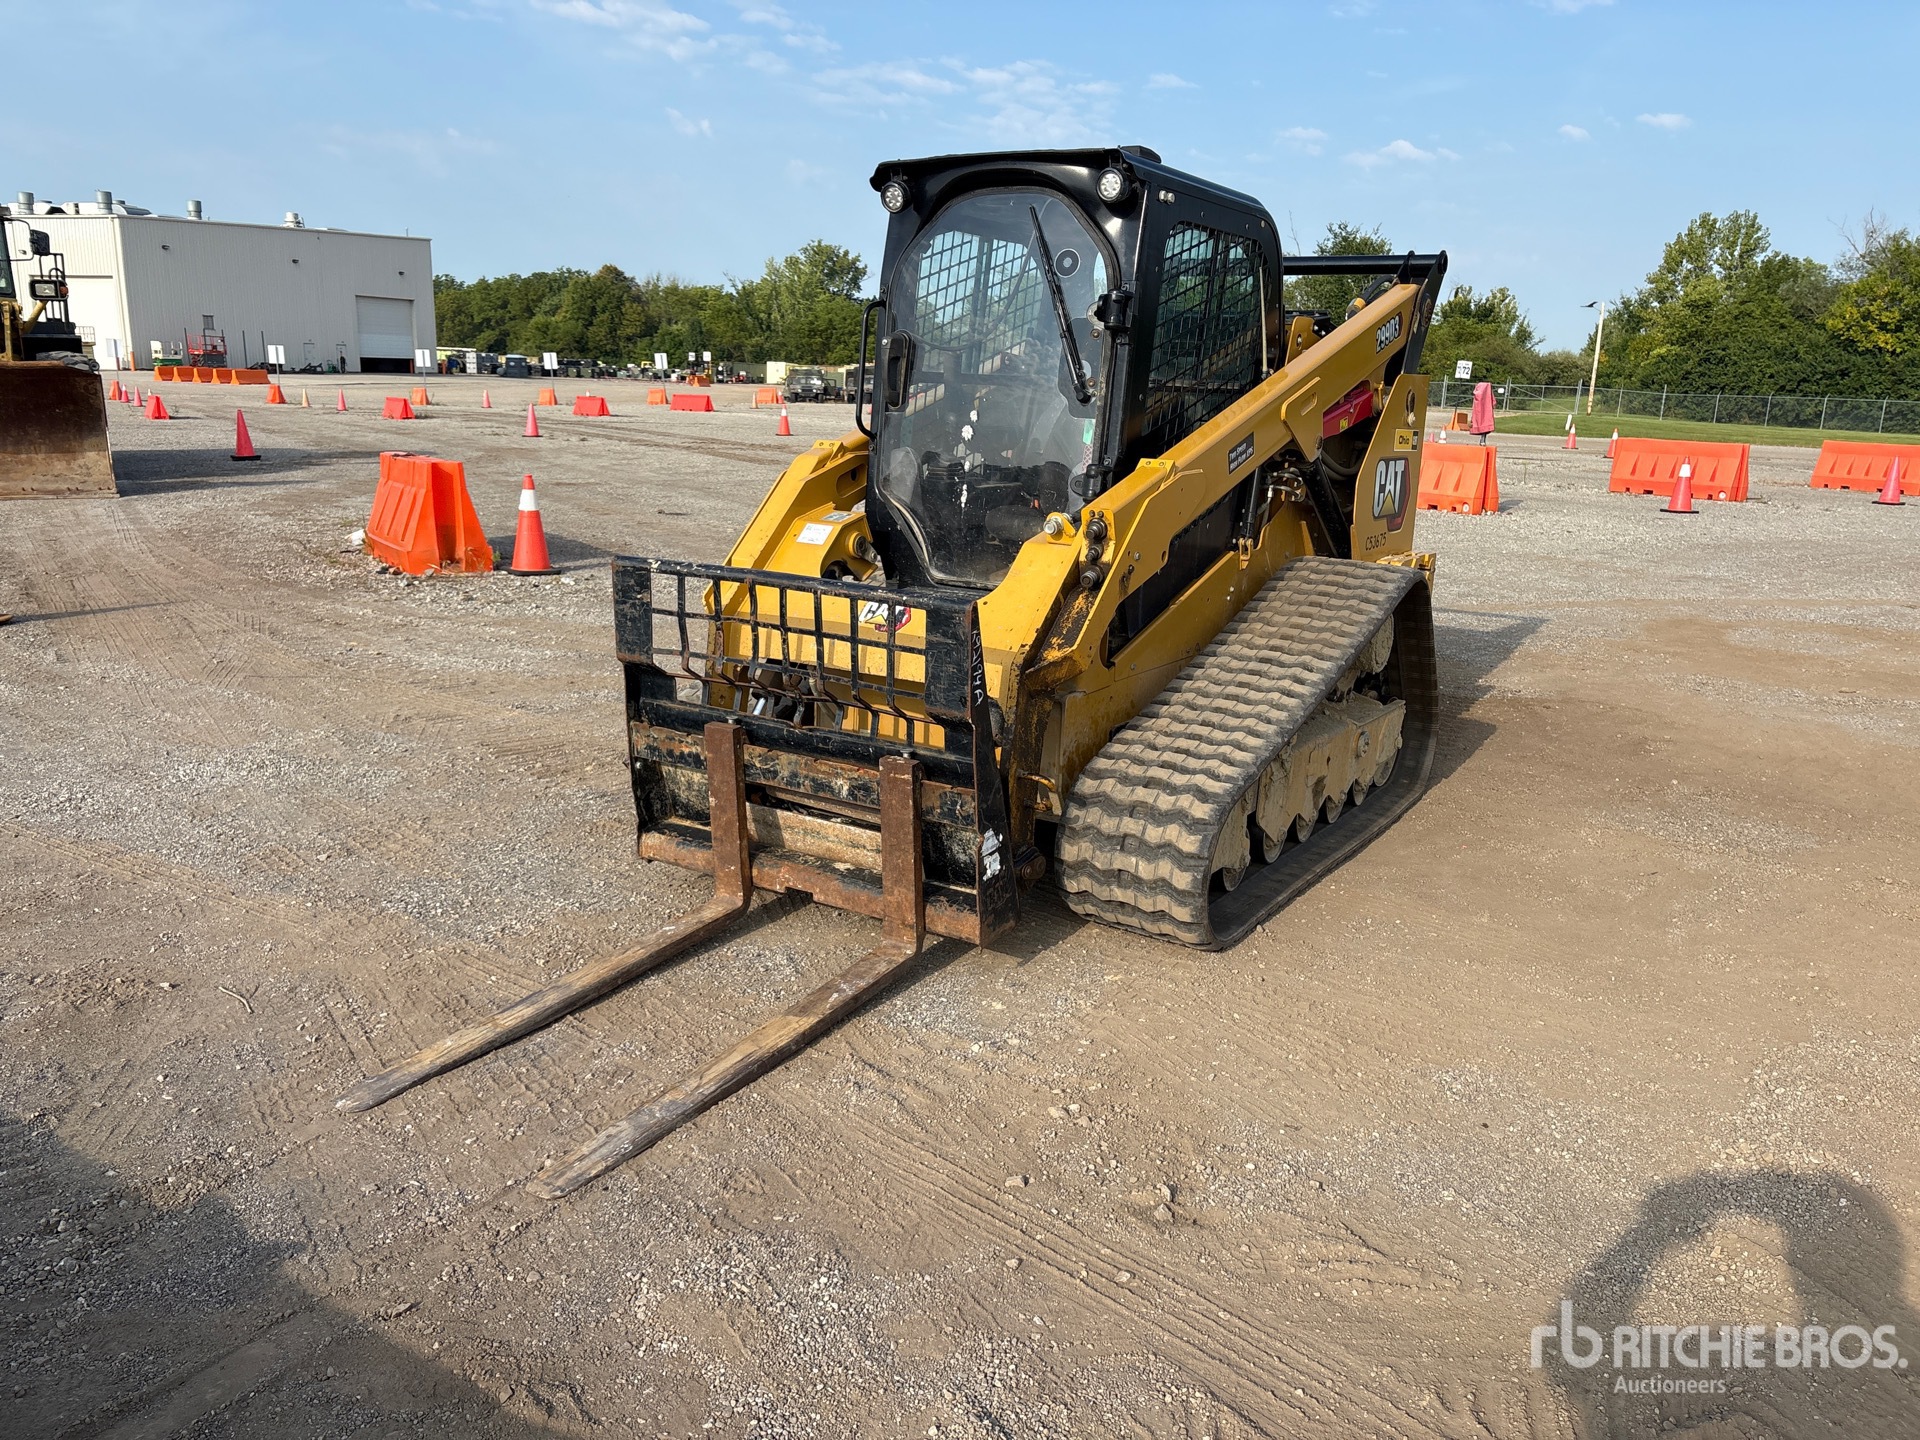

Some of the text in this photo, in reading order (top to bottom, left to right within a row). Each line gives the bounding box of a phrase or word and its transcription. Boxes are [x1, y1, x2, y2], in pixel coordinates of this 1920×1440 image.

[1376, 314, 1400, 353] 299D3
[1373, 460, 1405, 517] CAT
[1365, 532, 1387, 551] C53675
